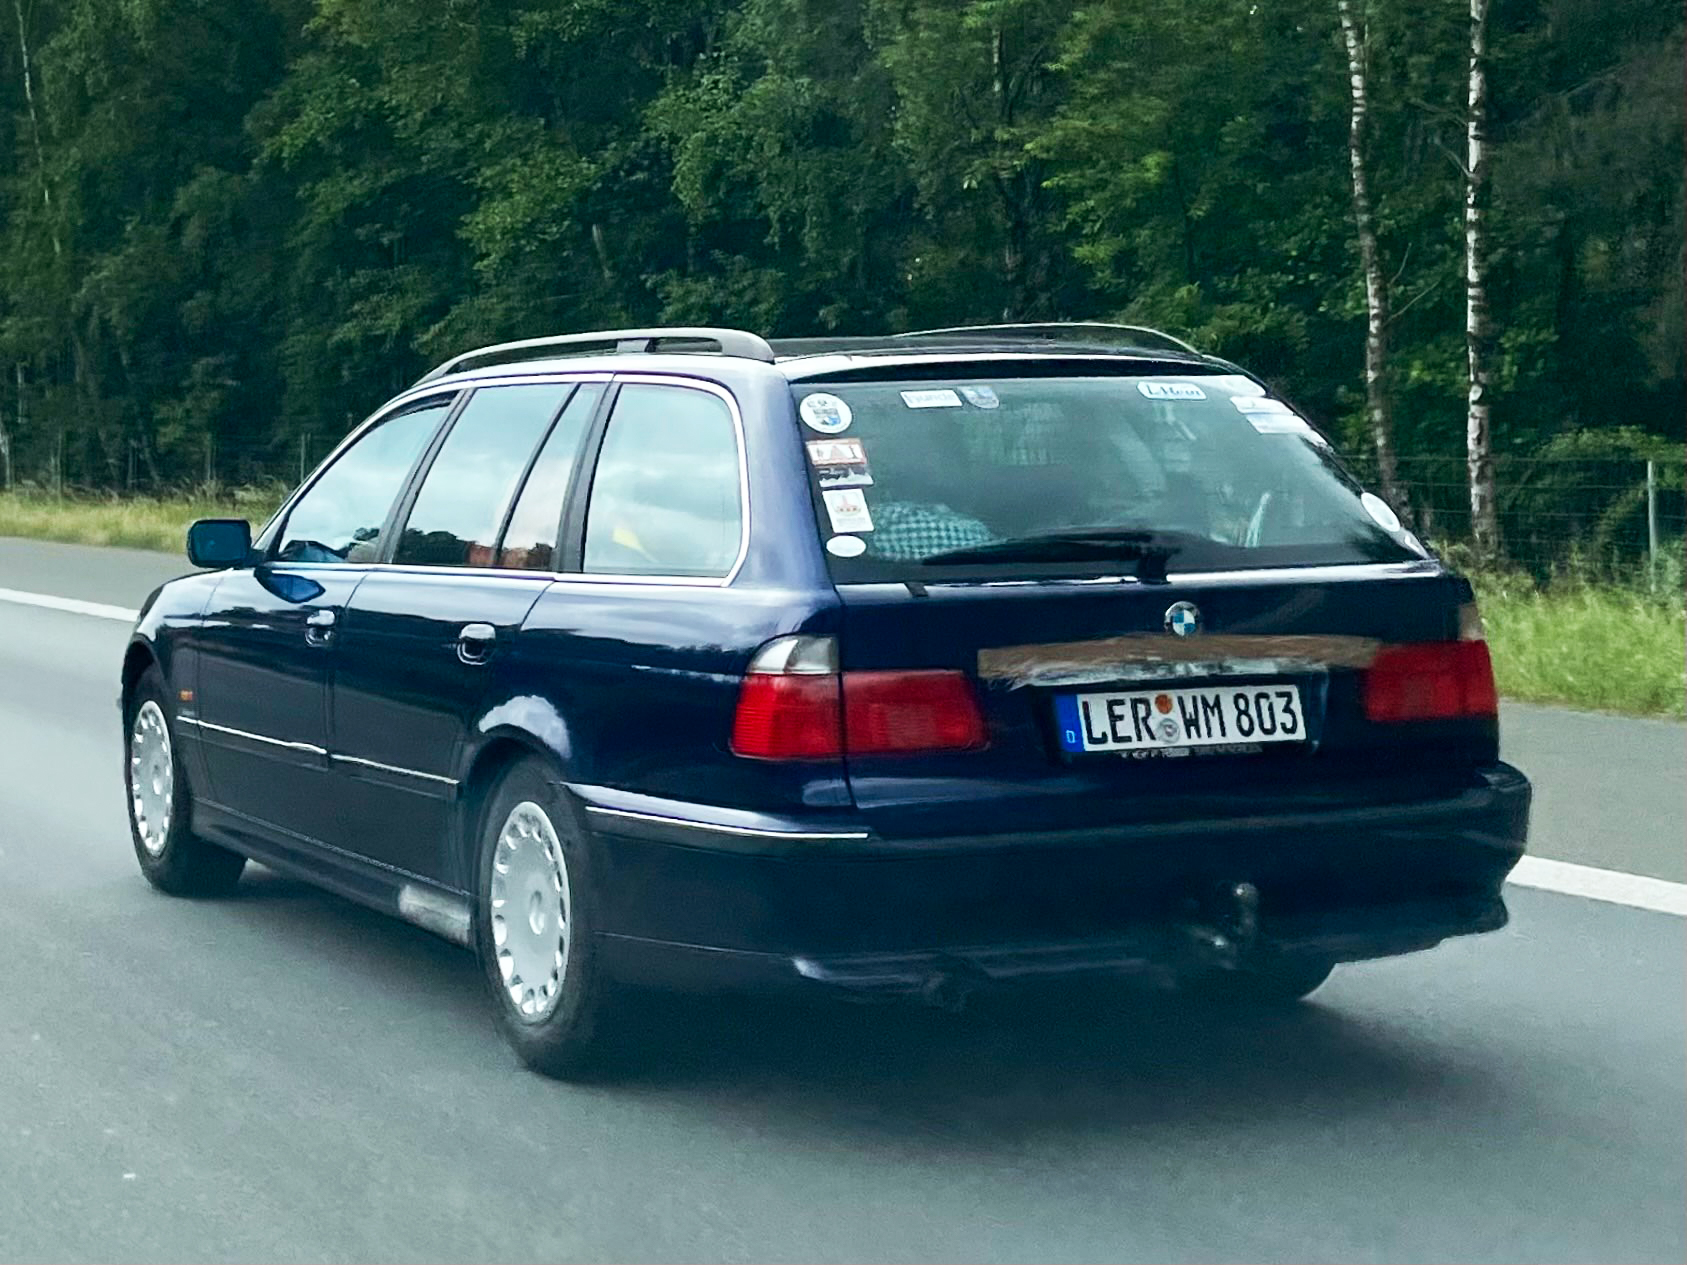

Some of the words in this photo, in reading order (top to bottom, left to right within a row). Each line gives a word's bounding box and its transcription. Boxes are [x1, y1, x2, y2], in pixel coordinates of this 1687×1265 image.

[1082, 697, 1155, 744] LER
[1177, 694, 1226, 739] WM
[1234, 691, 1298, 737] 803
[1066, 730, 1076, 744] D
